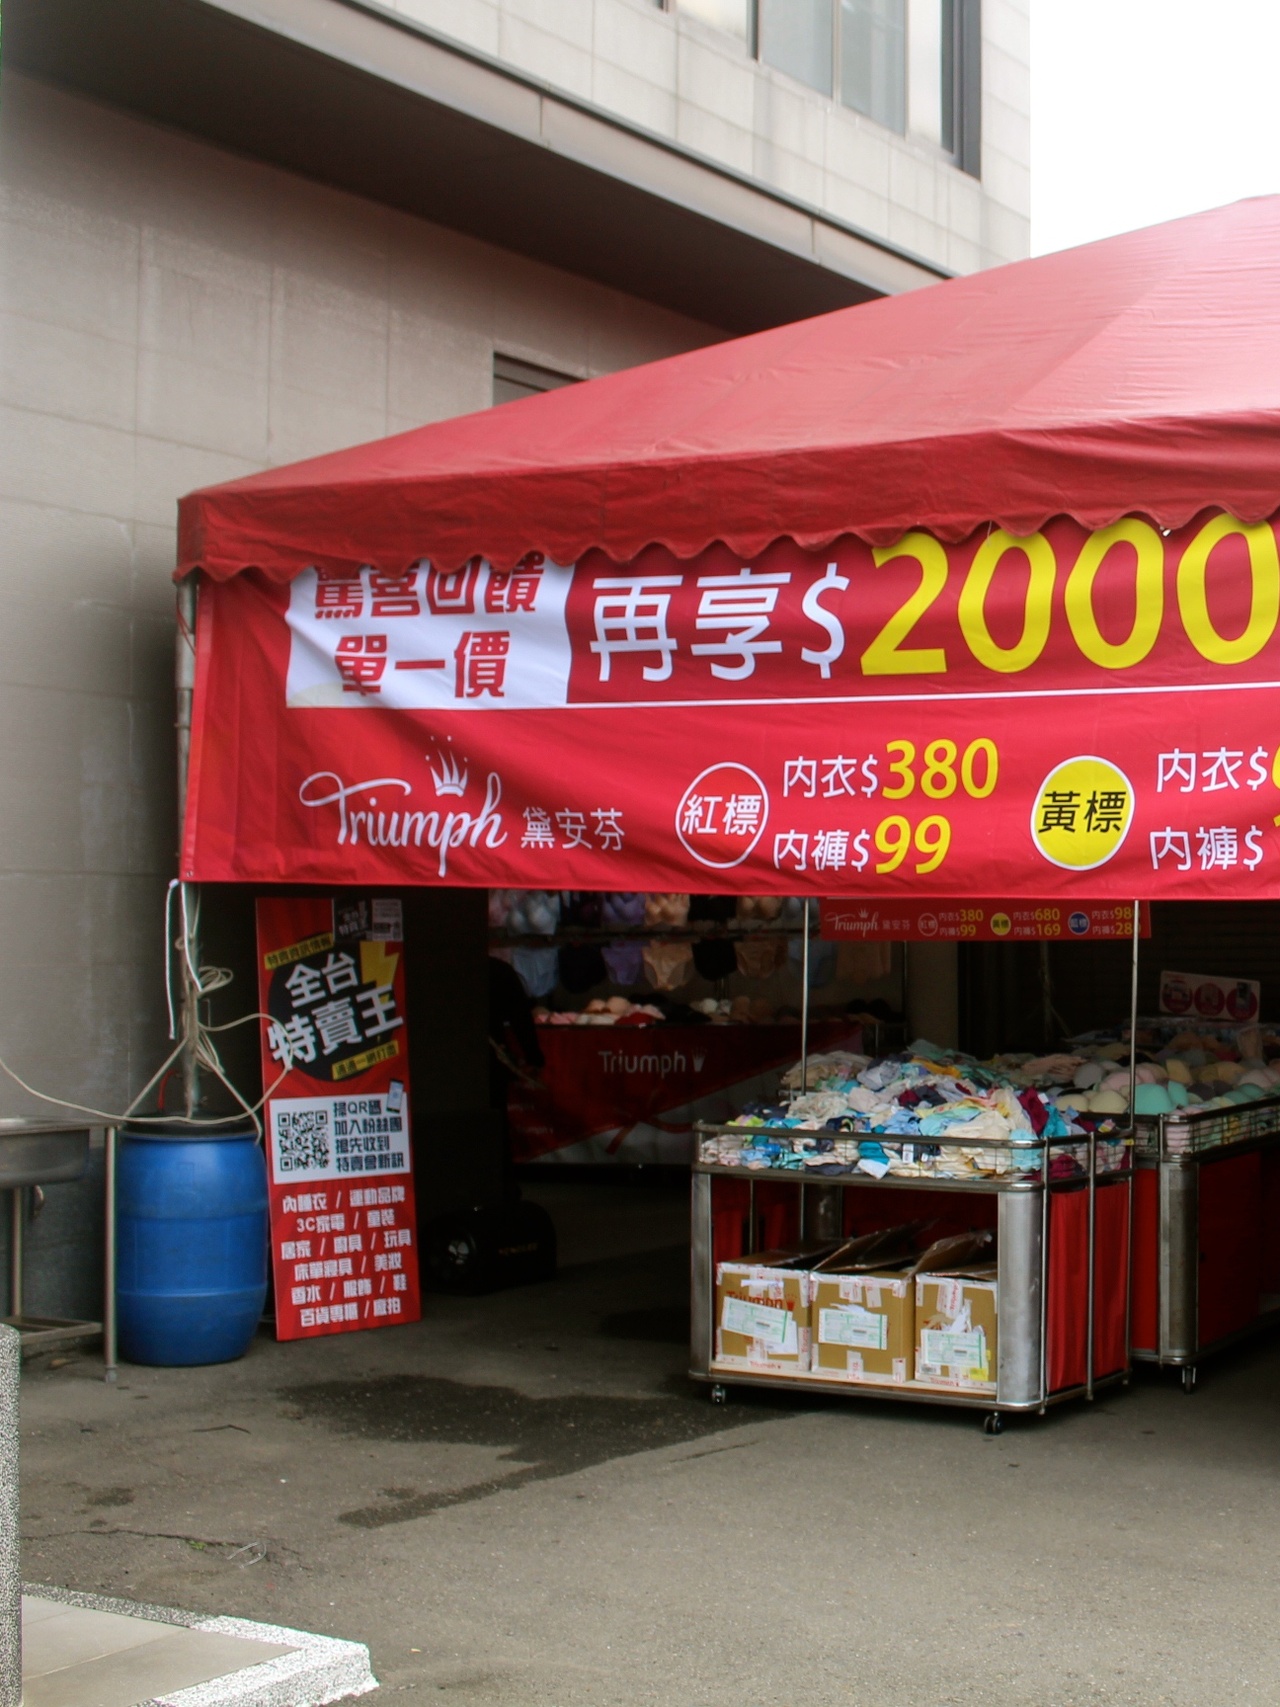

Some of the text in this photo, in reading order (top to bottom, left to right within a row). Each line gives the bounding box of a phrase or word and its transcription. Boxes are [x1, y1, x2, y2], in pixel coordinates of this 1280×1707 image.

[334, 630, 511, 698] 單一價
[299, 771, 626, 878] Triumph 黛安芬
[681, 793, 763, 836] 紅標
[1038, 790, 1128, 834] 黃標
[823, 911, 880, 937] Triumph
[284, 952, 359, 1009] 全台
[267, 984, 404, 1070] 特賣王
[598, 1050, 687, 1079] Triumph
